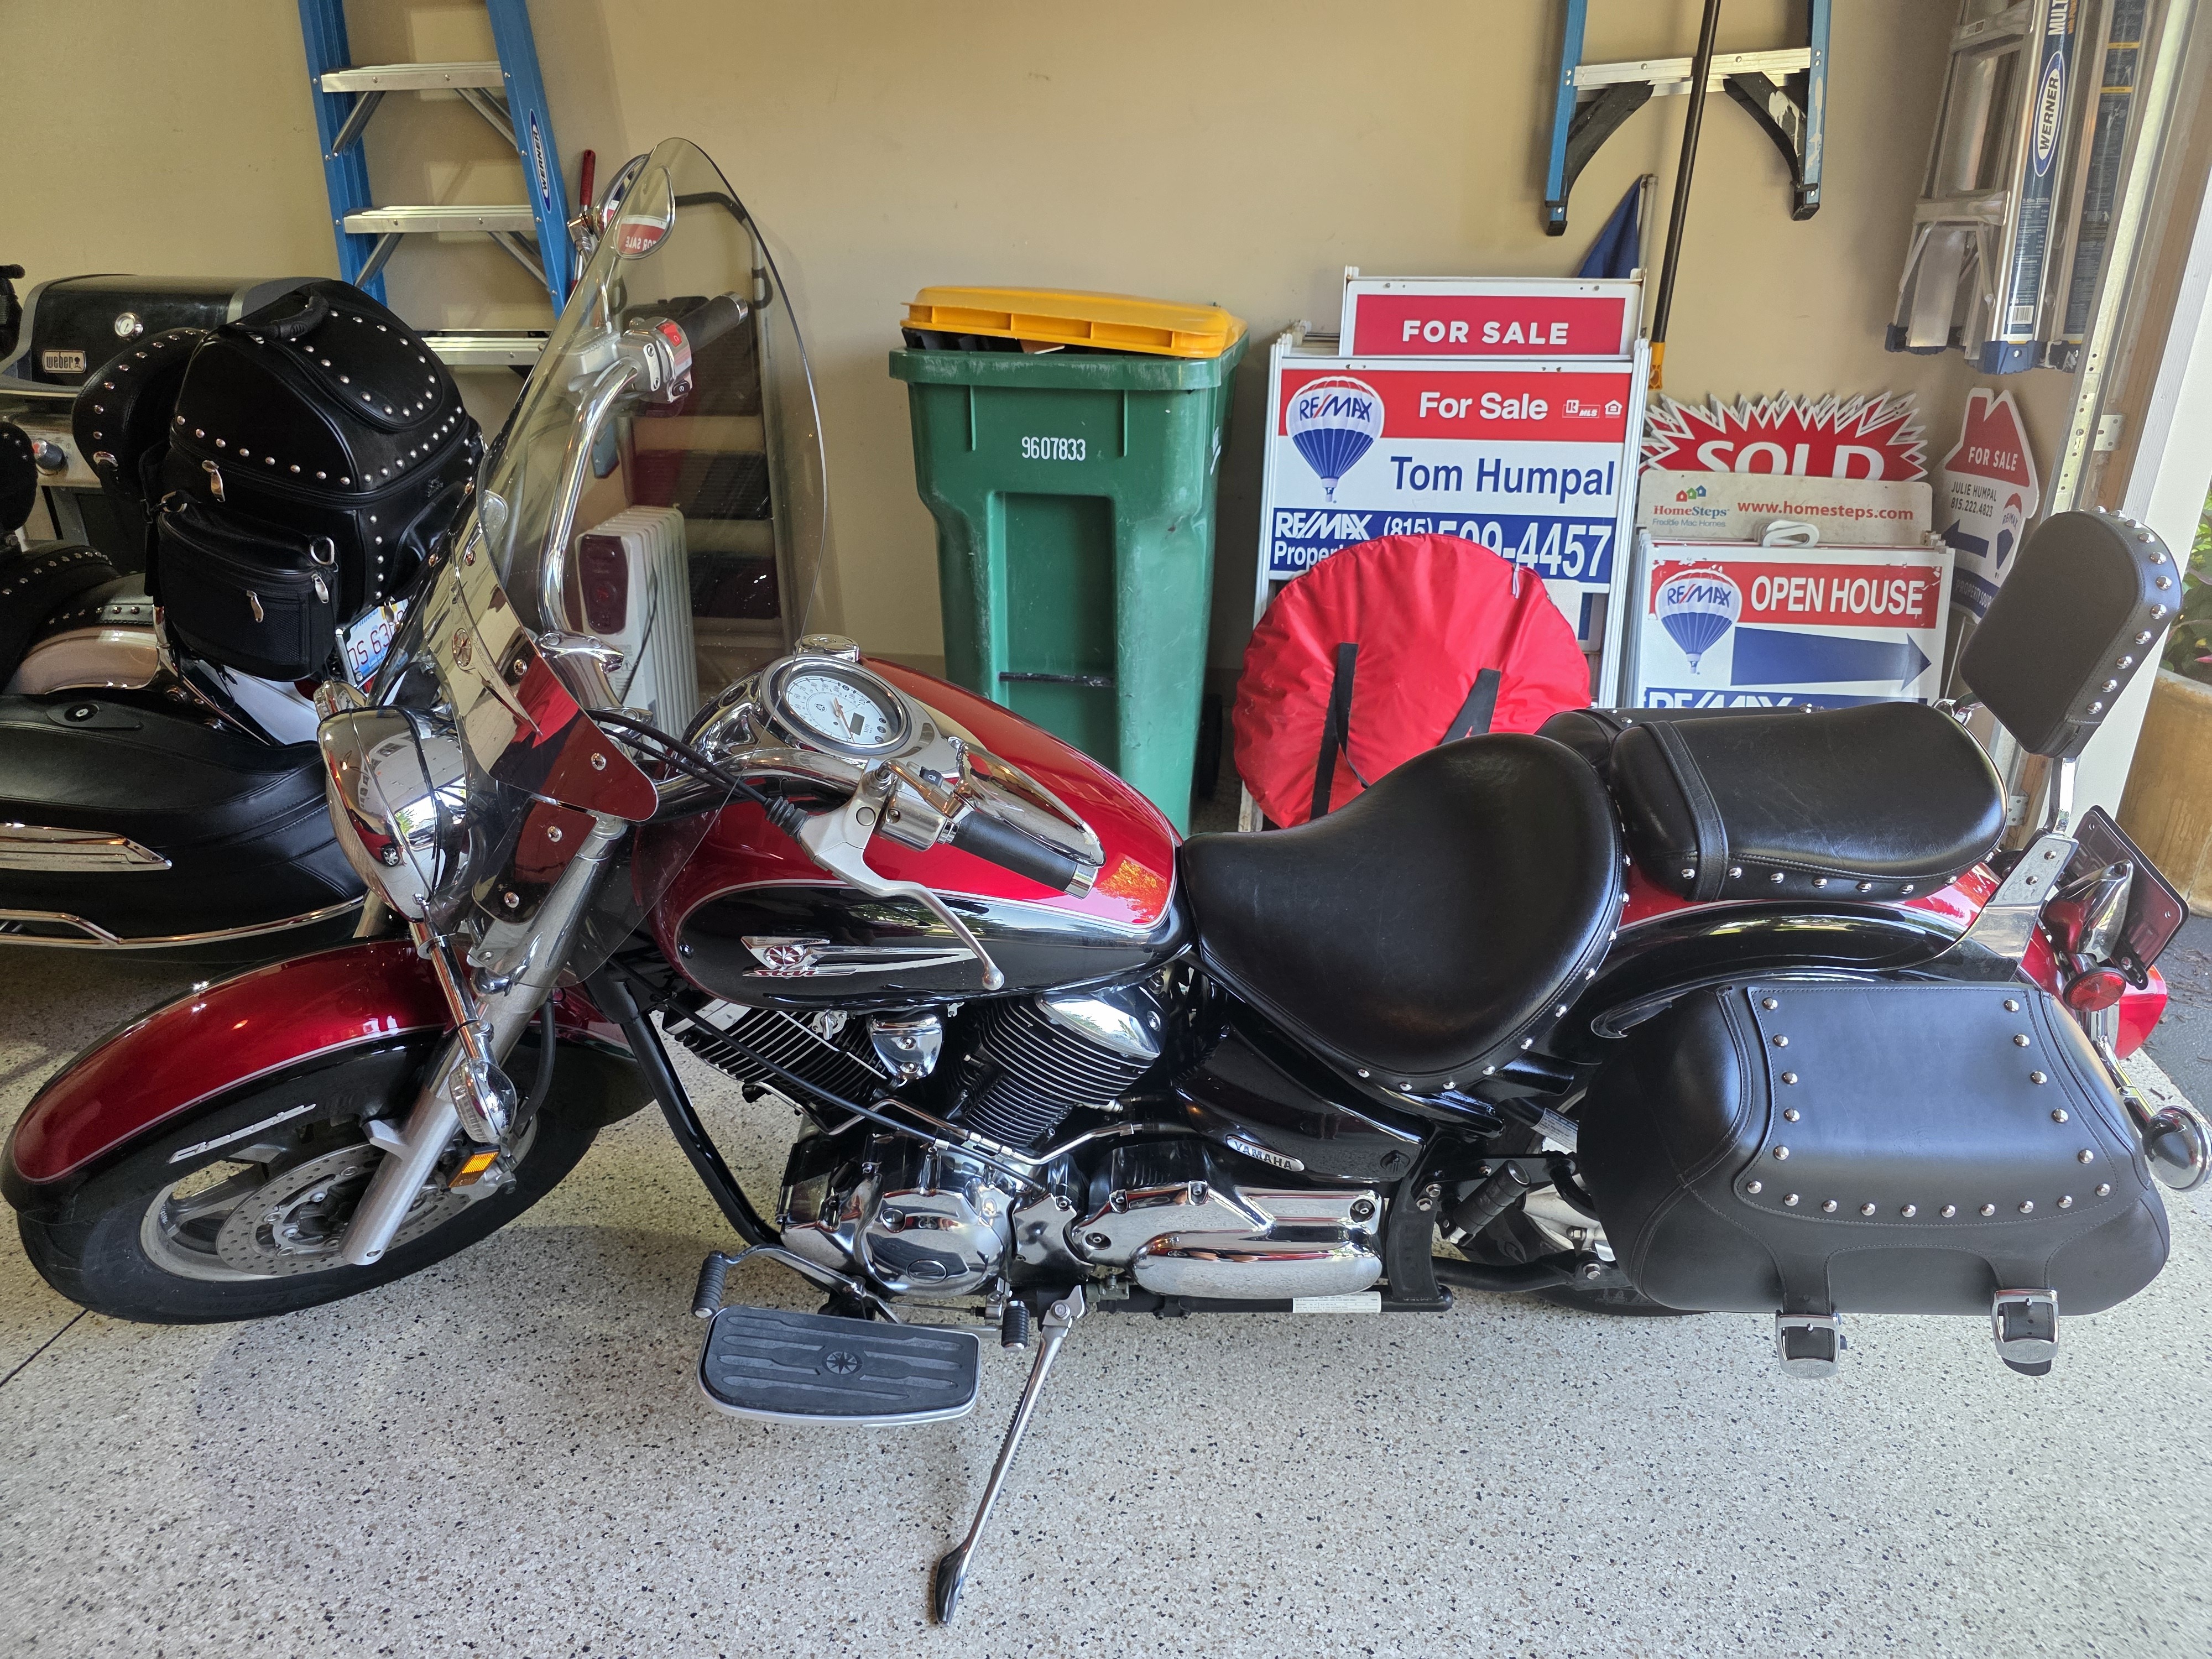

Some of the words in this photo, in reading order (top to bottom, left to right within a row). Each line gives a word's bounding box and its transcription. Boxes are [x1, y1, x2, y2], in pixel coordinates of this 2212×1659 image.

[2039, 77, 2059, 150] WERNER
[533, 131, 547, 190] WERNER
[1402, 321, 1468, 343] FOR
[1482, 322, 1569, 345] SALE
[46, 352, 74, 369] weber
[1298, 394, 1373, 423] RE/MAX
[1420, 392, 1472, 419] For
[1479, 393, 1548, 420] Sale
[1579, 409, 1598, 417] MLS
[1021, 436, 1086, 461] 9607833
[1968, 446, 1990, 466] FOR
[1993, 450, 2018, 471] SALE
[1390, 456, 1462, 492] Tom
[1477, 458, 1615, 504] Humpal
[1951, 481, 1971, 496] JULIE
[1972, 484, 1997, 502] HUMPAL
[1653, 505, 1727, 519] HomeSteps
[1738, 500, 1914, 520] www.homesteps.com
[2001, 512, 2018, 530] RE/MAX
[1275, 510, 1373, 540] RE/MAX
[1274, 540, 1343, 572] Prope
[1383, 516, 1432, 536] (815)
[1438, 520, 1612, 577] 9-4457
[1667, 585, 1731, 608] RE/MAX
[1750, 576, 1830, 613] OPEN
[1830, 578, 1924, 615] HOUSE
[1234, 1140, 1292, 1170] YAMAHA
